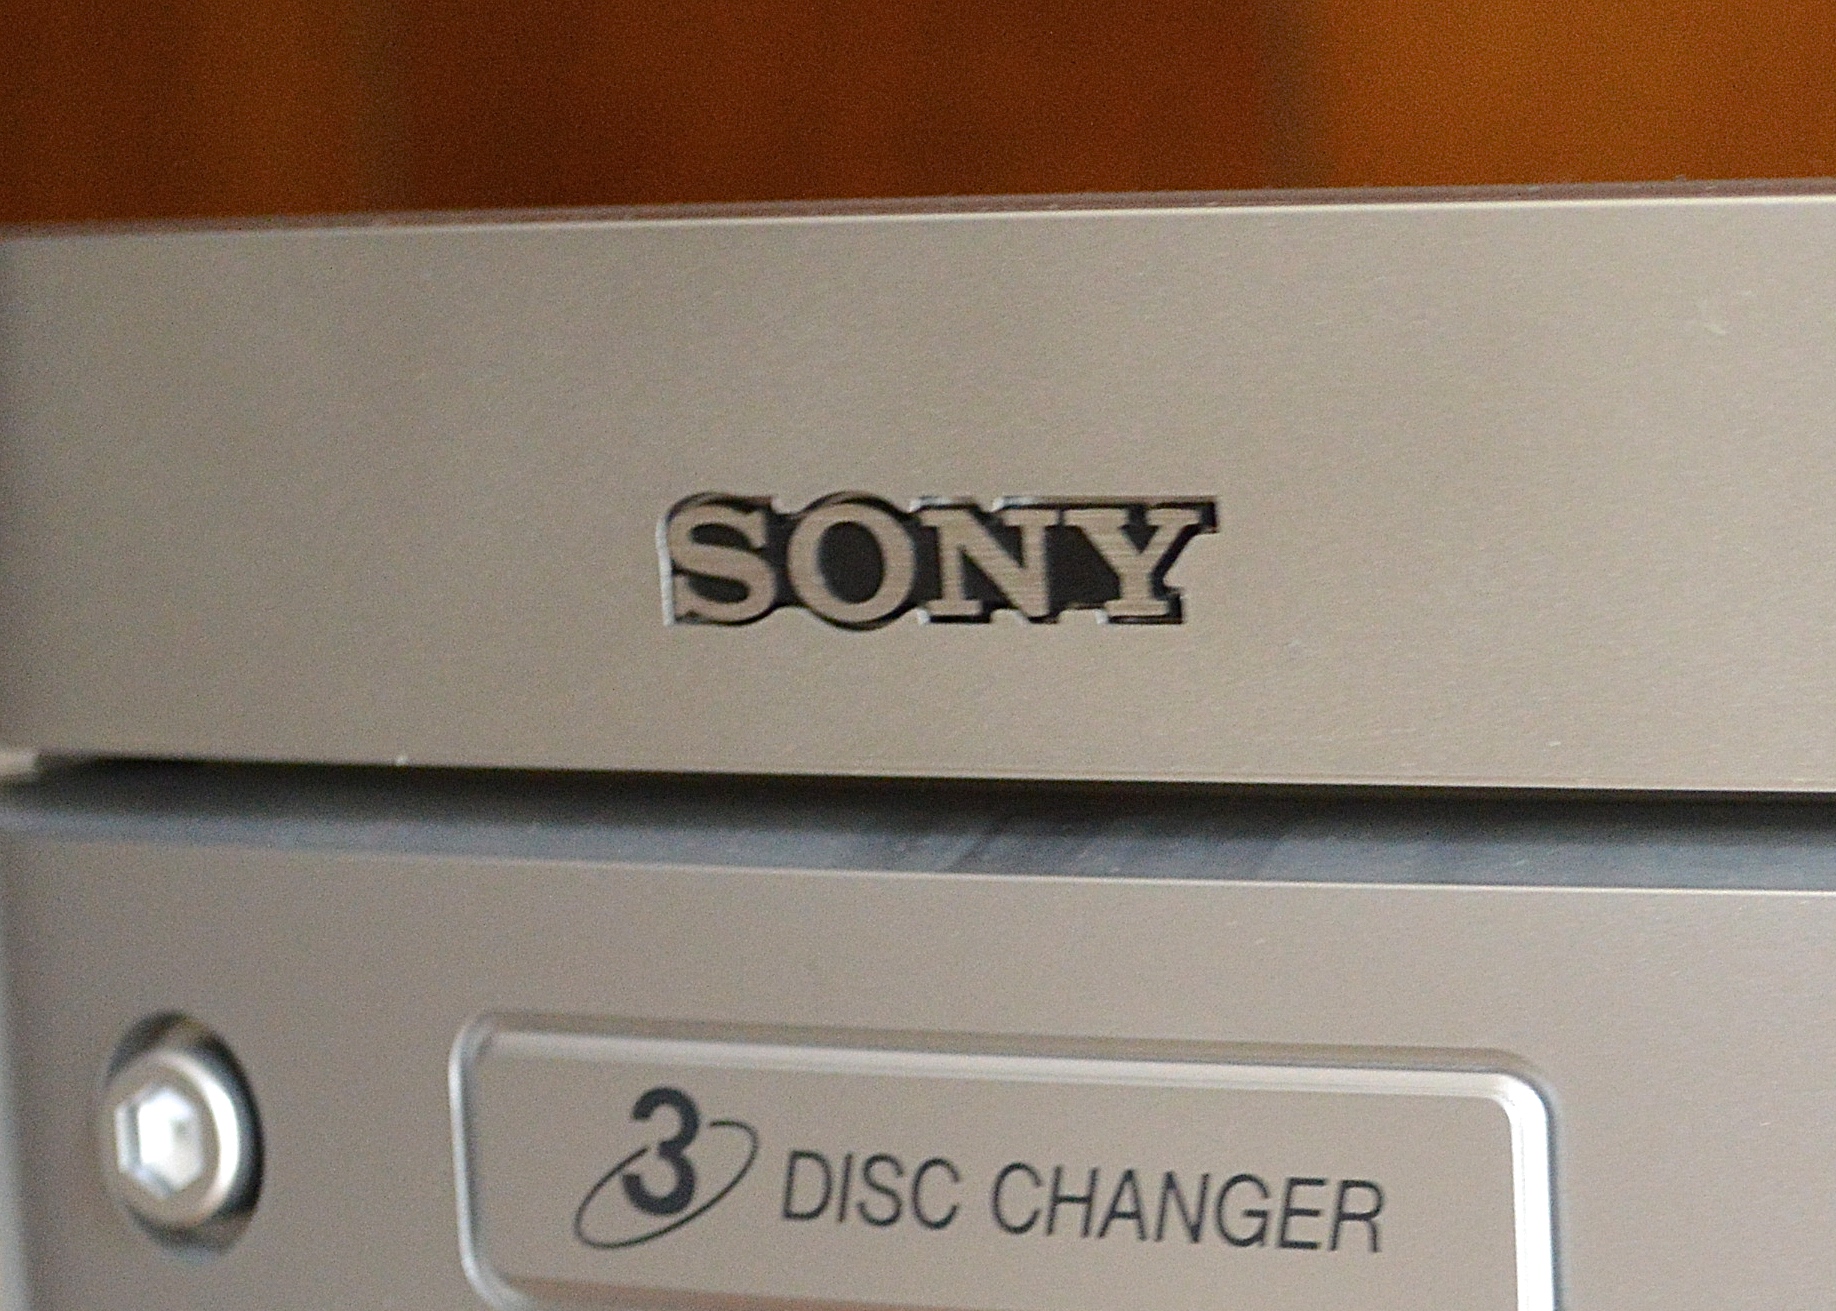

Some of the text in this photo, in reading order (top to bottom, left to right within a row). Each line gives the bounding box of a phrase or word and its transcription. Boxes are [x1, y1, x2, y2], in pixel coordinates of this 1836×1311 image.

[660, 495, 1218, 631] SONY
[620, 1087, 1386, 1254] 3 DISC CHANGER
